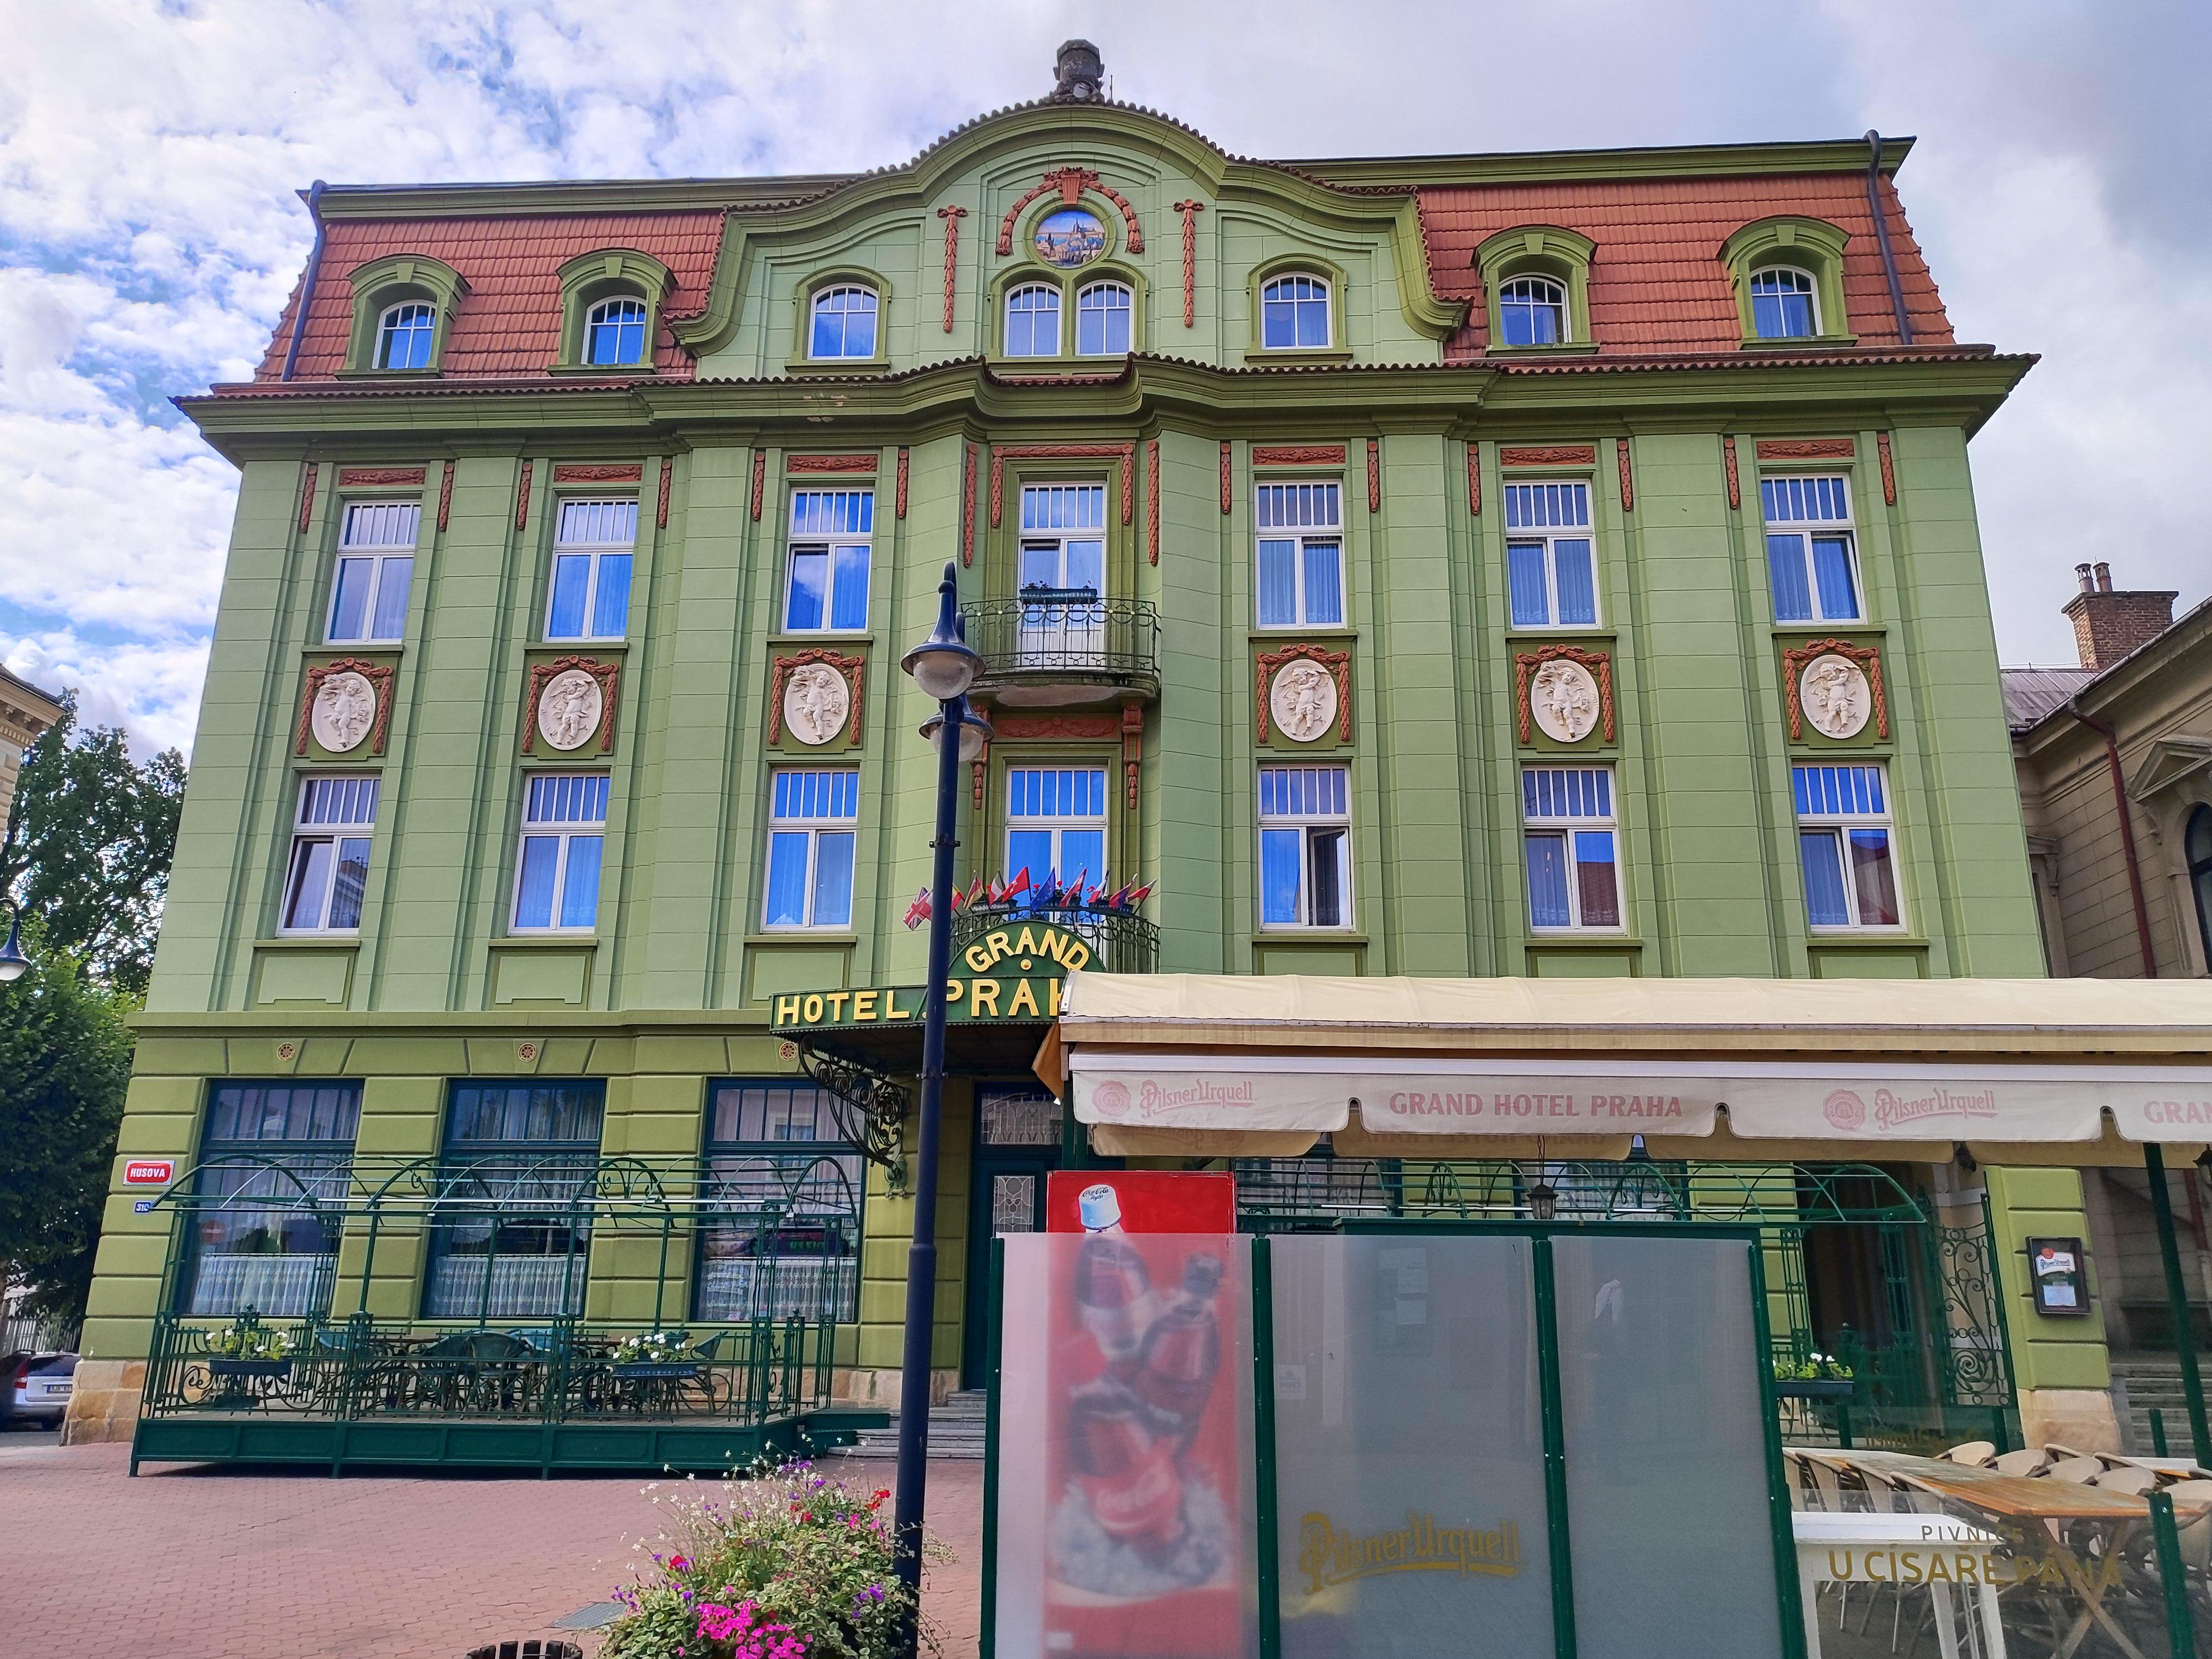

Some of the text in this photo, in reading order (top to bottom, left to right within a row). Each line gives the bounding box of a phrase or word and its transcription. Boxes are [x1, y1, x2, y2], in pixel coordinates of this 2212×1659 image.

[965, 926, 1089, 972] GRAND
[777, 990, 910, 1025] HOTEL
[1139, 1079, 1197, 1119] Pilsner
[1196, 1078, 1253, 1110] Urquell
[1389, 1092, 1683, 1118] GRAND HOTEL PRAHA
[1874, 1088, 1936, 1131] Pilsner
[1933, 1087, 1996, 1119] Urquell
[130, 1168, 165, 1178] HUSOVA
[1298, 1509, 1521, 1595] Pilsner Urquell
[1828, 1550, 1853, 1581] U
